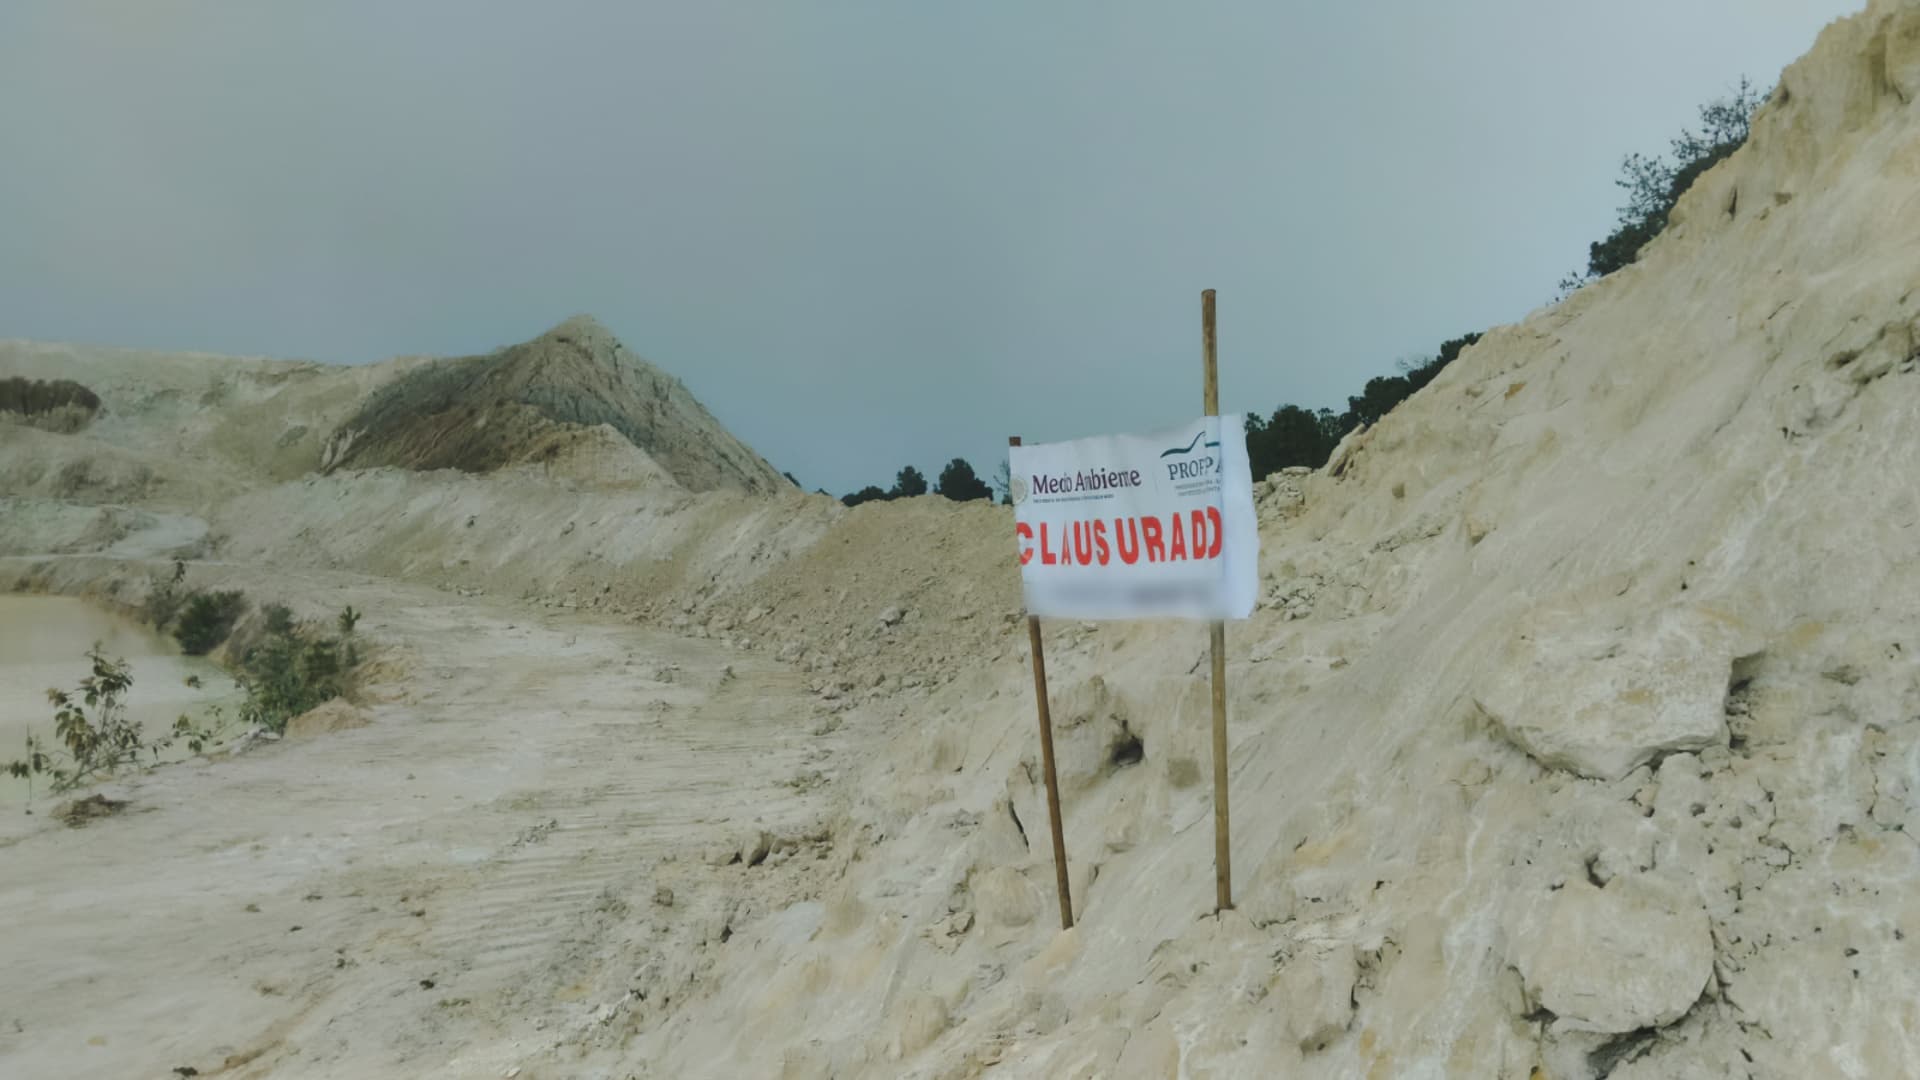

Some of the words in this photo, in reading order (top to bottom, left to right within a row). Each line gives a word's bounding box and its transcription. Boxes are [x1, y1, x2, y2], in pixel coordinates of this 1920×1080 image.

[1032, 472, 1072, 495] Medo
[1074, 467, 1142, 492] Ambiene
[1167, 456, 1221, 480] PROFP
